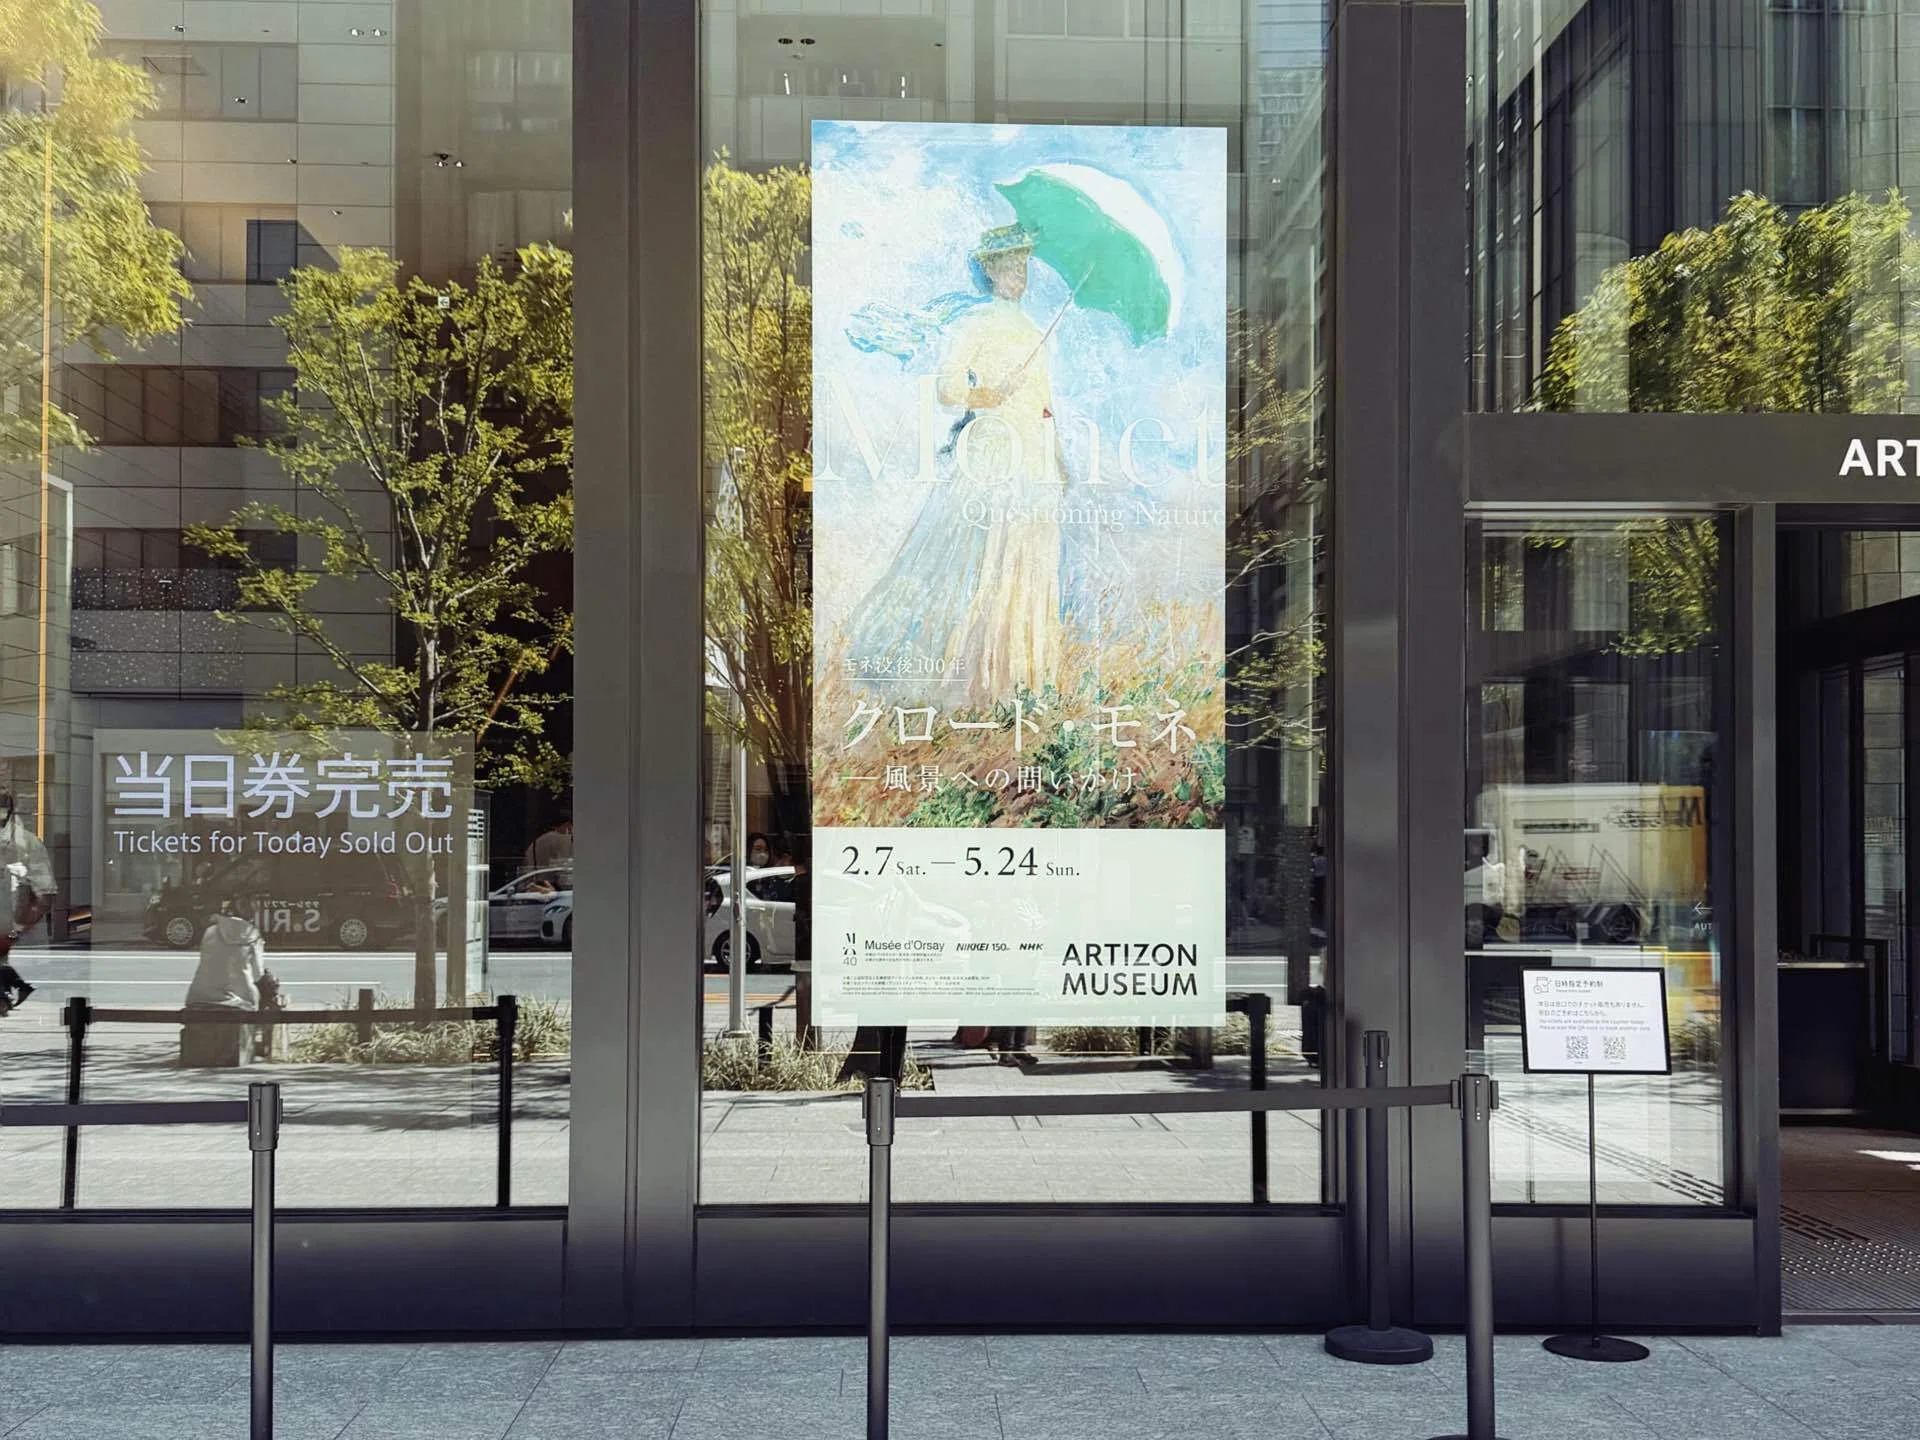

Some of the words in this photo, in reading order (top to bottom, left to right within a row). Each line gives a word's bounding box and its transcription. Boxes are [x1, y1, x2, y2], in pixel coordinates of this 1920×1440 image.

[812, 374, 1226, 487] Monet
[962, 498, 1126, 532] Questioning
[842, 656, 966, 675] モネ没後100年
[842, 698, 1196, 753] クロード・モネ
[114, 751, 453, 819] 当日券完売
[114, 830, 201, 854] Tickets
[208, 830, 247, 854] for
[252, 831, 331, 859] Today
[340, 831, 396, 854] Sold
[405, 832, 453, 854] Out
[842, 846, 894, 876] 2.7
[896, 861, 926, 876] Sat.
[964, 846, 1038, 876] 5.24
[1046, 861, 1080, 876] Sun.
[865, 939, 902, 951] Musée
[956, 942, 990, 952] NIKKEI
[1019, 943, 1044, 951] NHK
[1063, 943, 1198, 967] ARTIZON
[1062, 973, 1198, 996] MUSEUM
